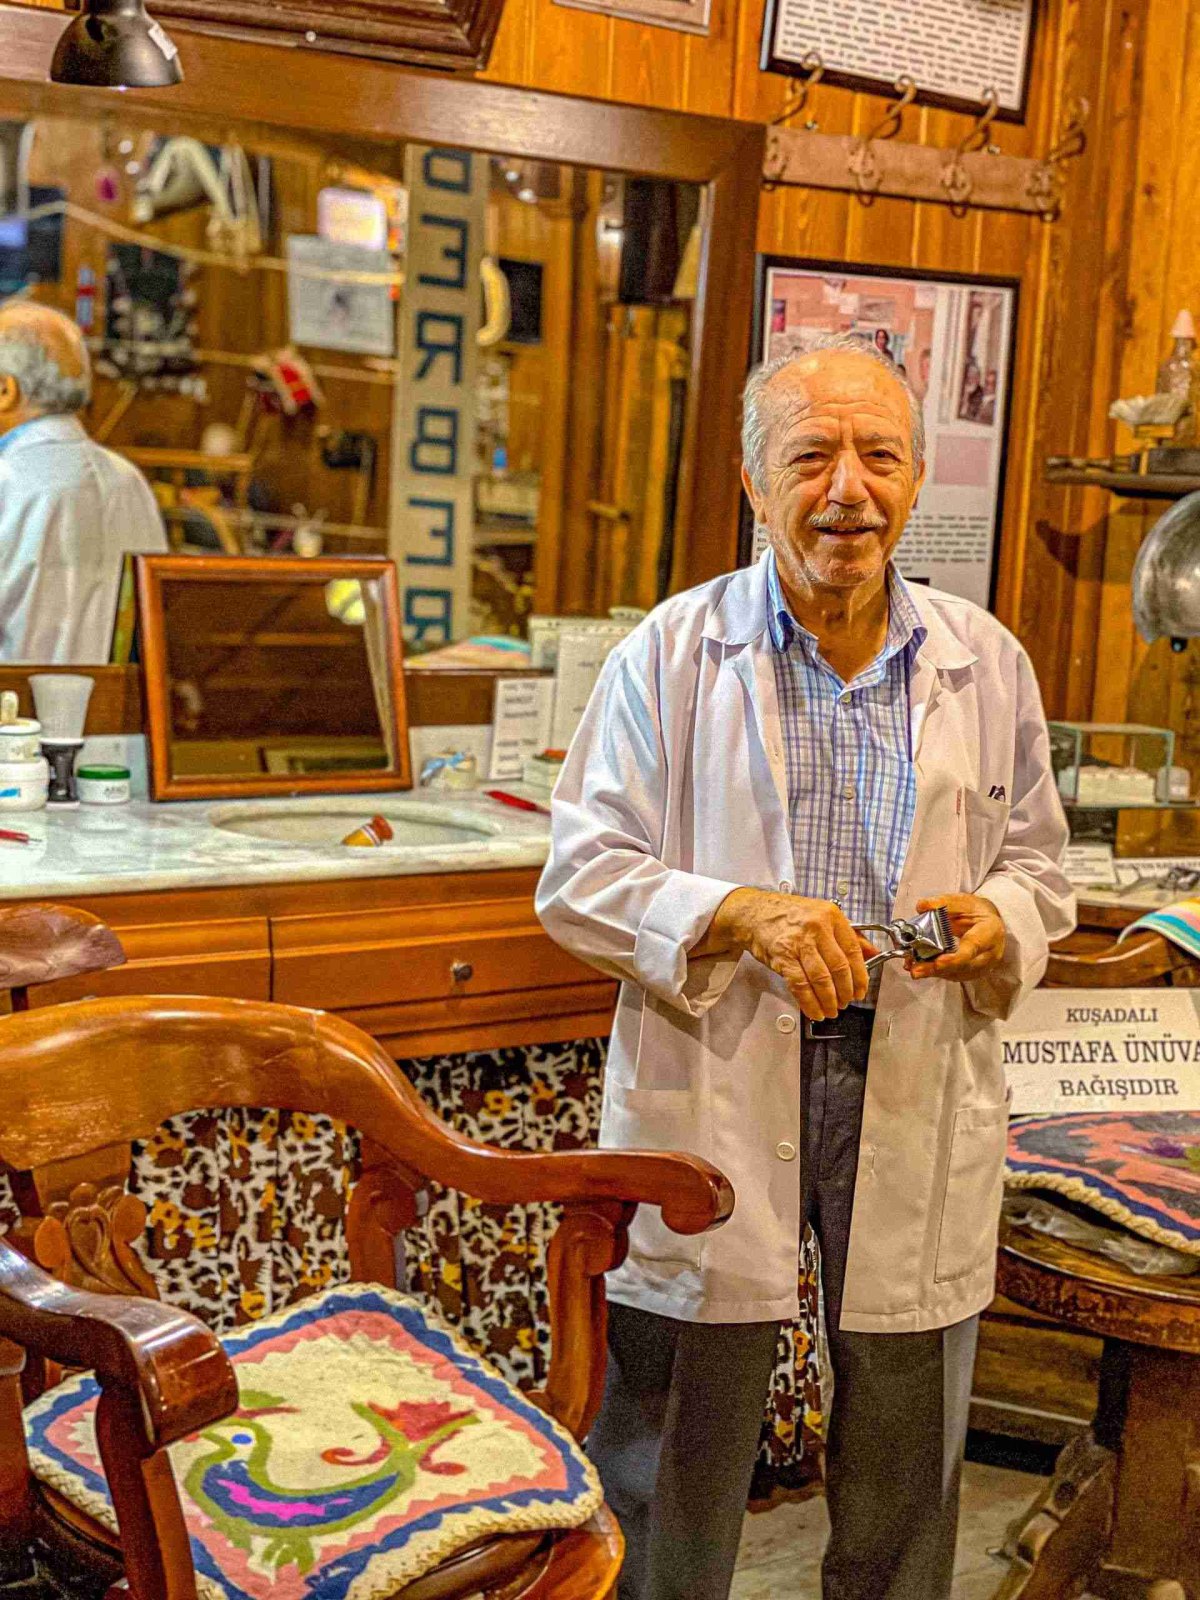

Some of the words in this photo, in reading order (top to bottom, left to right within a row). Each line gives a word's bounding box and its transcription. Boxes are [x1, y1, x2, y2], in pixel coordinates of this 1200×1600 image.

[1065, 1008, 1158, 1026] KUŞADALI
[1002, 1040, 1118, 1064] MUSTAFA
[1060, 1075, 1179, 1100] BAĞIŞIDIR
